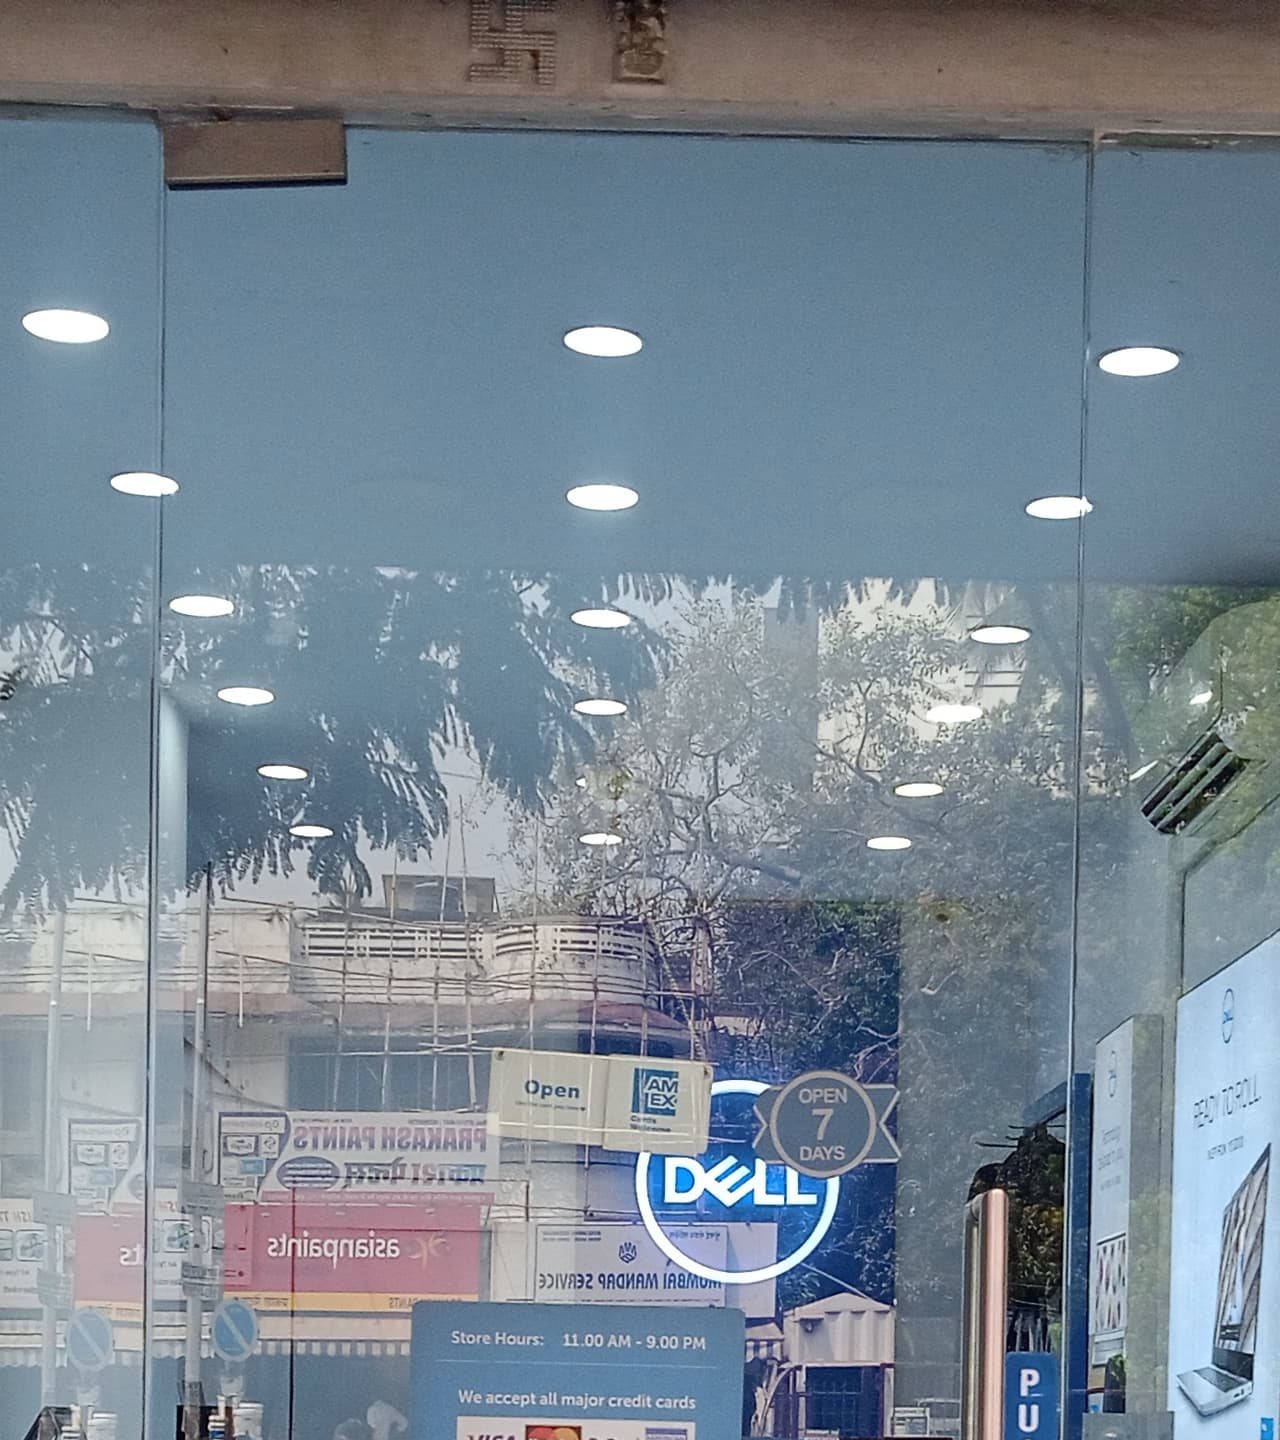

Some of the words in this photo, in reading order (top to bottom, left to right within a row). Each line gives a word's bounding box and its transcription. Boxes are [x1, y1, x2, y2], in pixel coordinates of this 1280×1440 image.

[524, 1079, 581, 1099] Open
[646, 1077, 679, 1093] AM
[649, 1093, 677, 1108] EX
[798, 1088, 848, 1104] OPEN
[811, 1107, 835, 1141] 7
[799, 1145, 846, 1161] DAYS
[664, 1154, 818, 1208] DELL
[451, 1330, 492, 1346] Store
[495, 1331, 545, 1347] Hours:
[563, 1333, 604, 1348] 11.00
[607, 1334, 632, 1349] AM
[646, 1335, 680, 1350] 9.00
[683, 1336, 707, 1350] PM
[458, 1389, 483, 1404] We
[486, 1391, 537, 1408] accept
[540, 1391, 558, 1406] all
[561, 1392, 605, 1410] major
[608, 1393, 653, 1409] credit
[655, 1394, 697, 1410] cards
